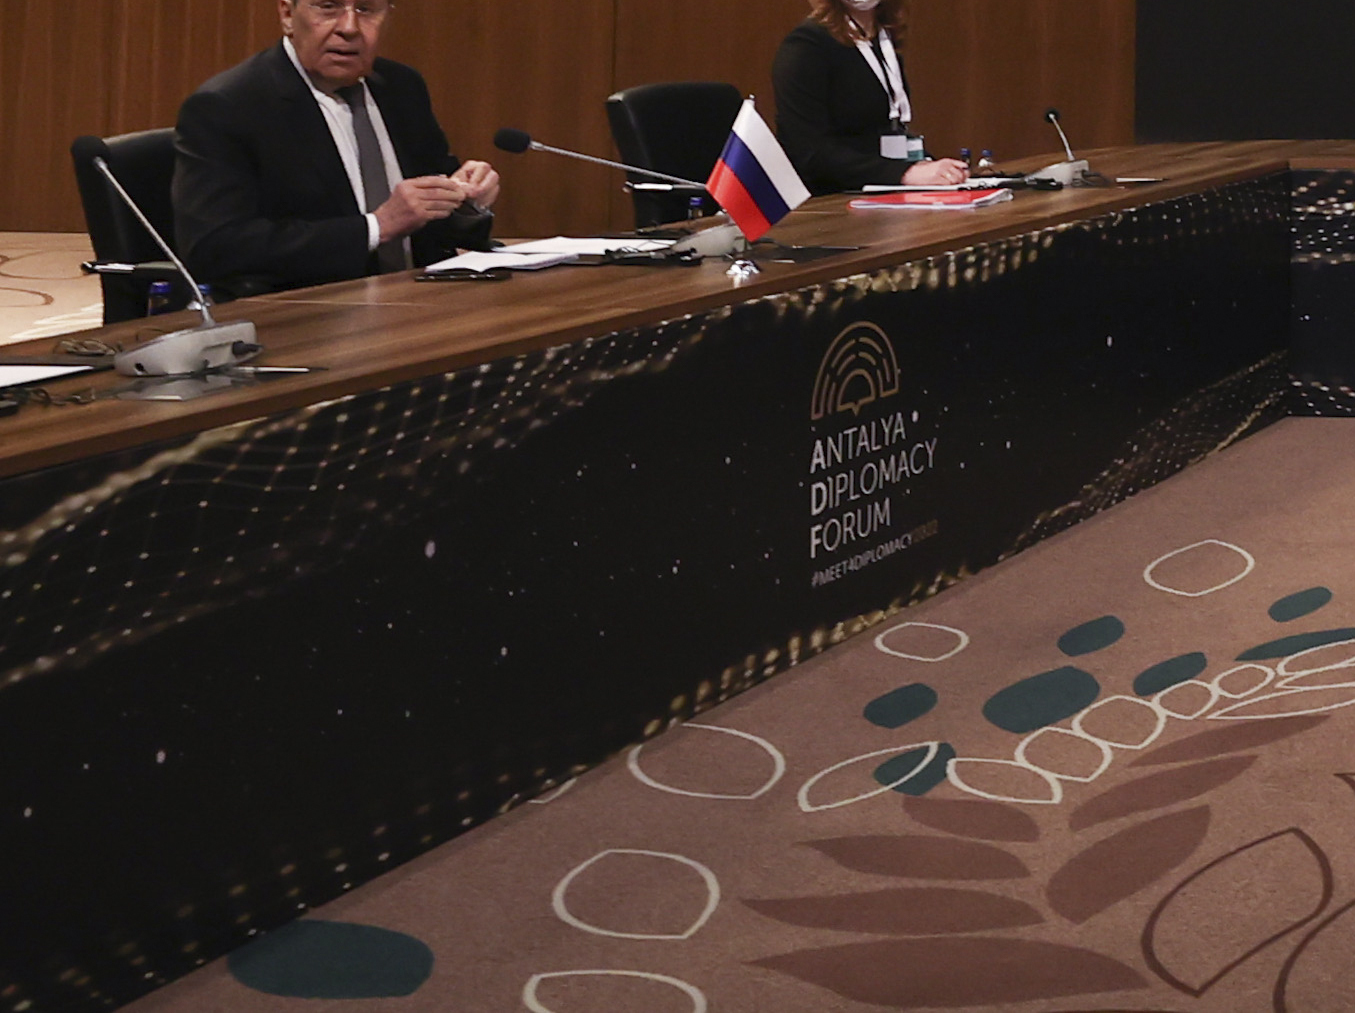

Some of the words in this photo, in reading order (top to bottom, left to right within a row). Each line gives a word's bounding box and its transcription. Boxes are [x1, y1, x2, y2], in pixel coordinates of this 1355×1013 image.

[810, 412, 906, 474] ANTALYA
[811, 438, 938, 516] DIPLOMACY
[810, 497, 891, 559] FORUM
